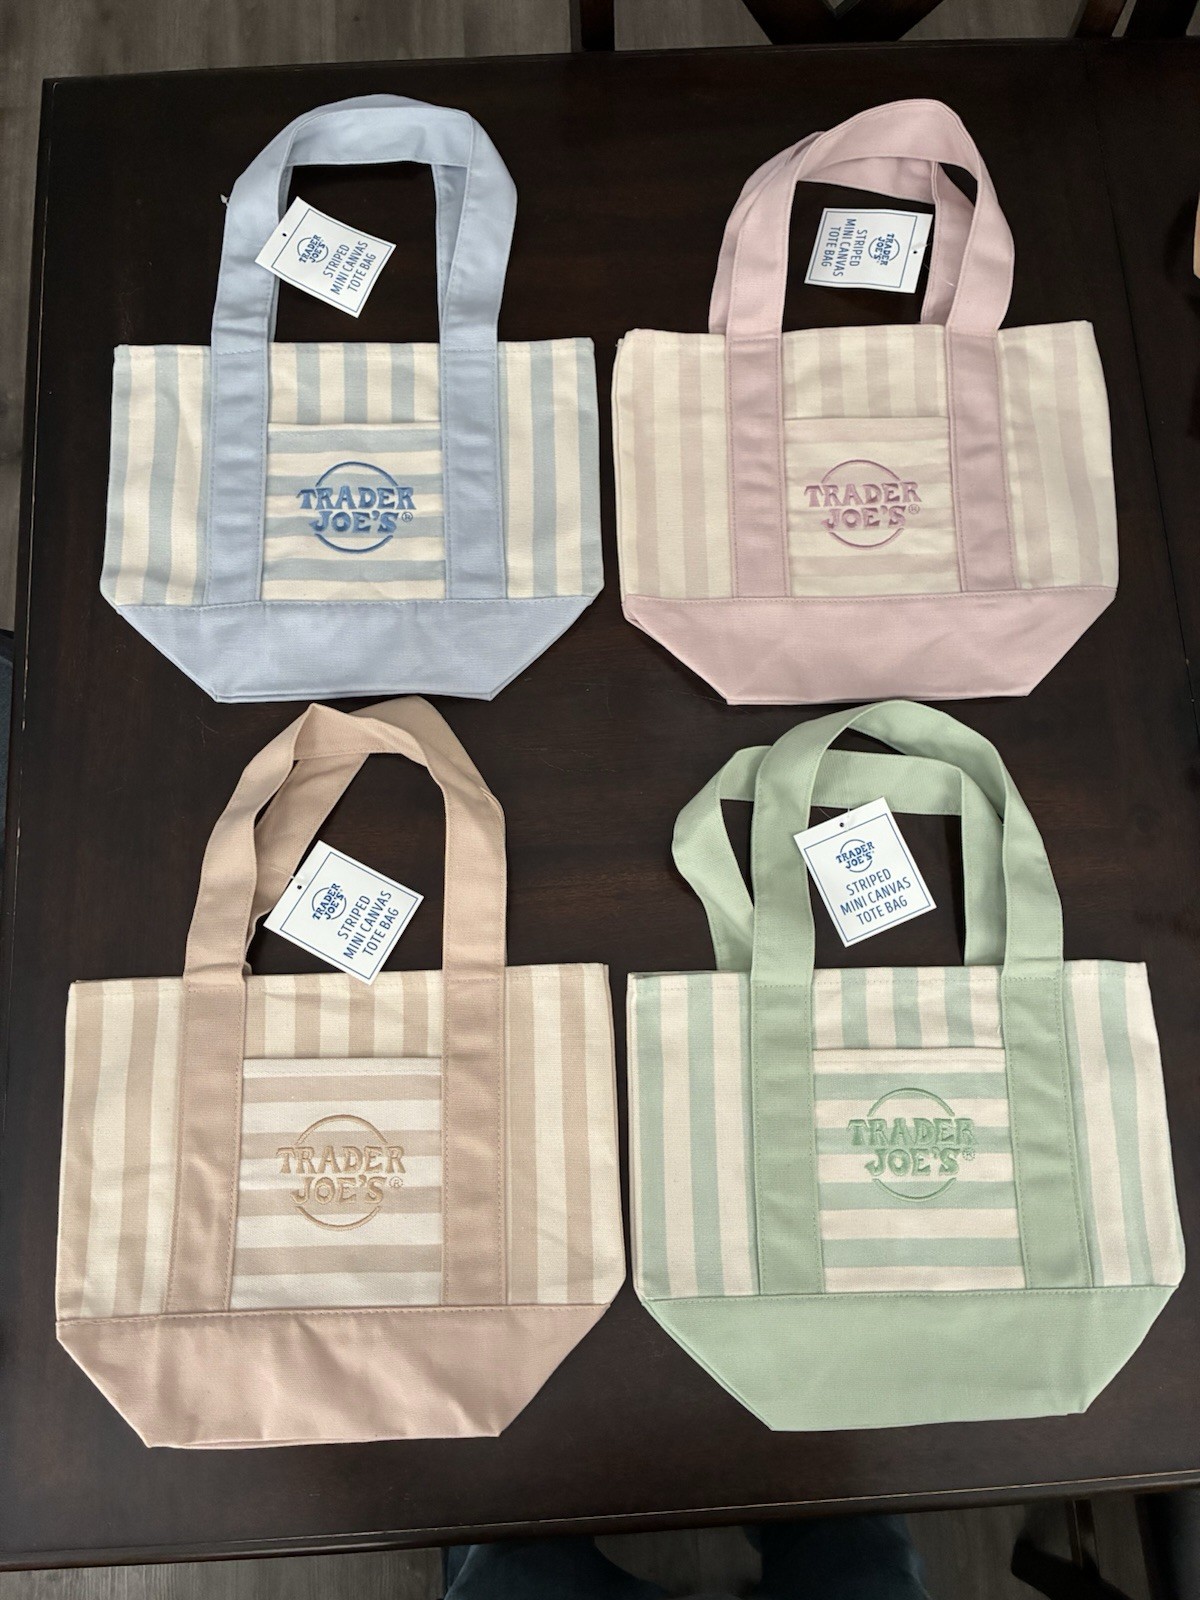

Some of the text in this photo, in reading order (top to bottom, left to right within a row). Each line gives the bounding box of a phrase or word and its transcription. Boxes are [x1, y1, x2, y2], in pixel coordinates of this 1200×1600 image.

[299, 234, 321, 263] TRADER
[323, 244, 350, 278] STRIPED
[821, 226, 841, 267] TOTE BAG
[833, 218, 857, 277] MINI CANVAS
[849, 229, 868, 267] STRIPED
[880, 233, 895, 266] TRADER
[330, 241, 368, 295] MINI CANVAS
[347, 253, 377, 292] TOTE BAG
[296, 485, 417, 510] TRADER
[804, 481, 922, 507] TRADER
[836, 841, 875, 864] TRADER
[840, 876, 912, 916] MINI CANVAS
[846, 868, 891, 896] STRIPED
[312, 883, 341, 920] TRADER
[337, 895, 371, 940] STRIPED
[856, 895, 908, 925] TOTE BAG
[343, 890, 392, 960] MINI CANVAS
[362, 907, 399, 956] TOTE BAG
[847, 1117, 979, 1146] TRADER
[276, 1145, 406, 1174] TRADER
